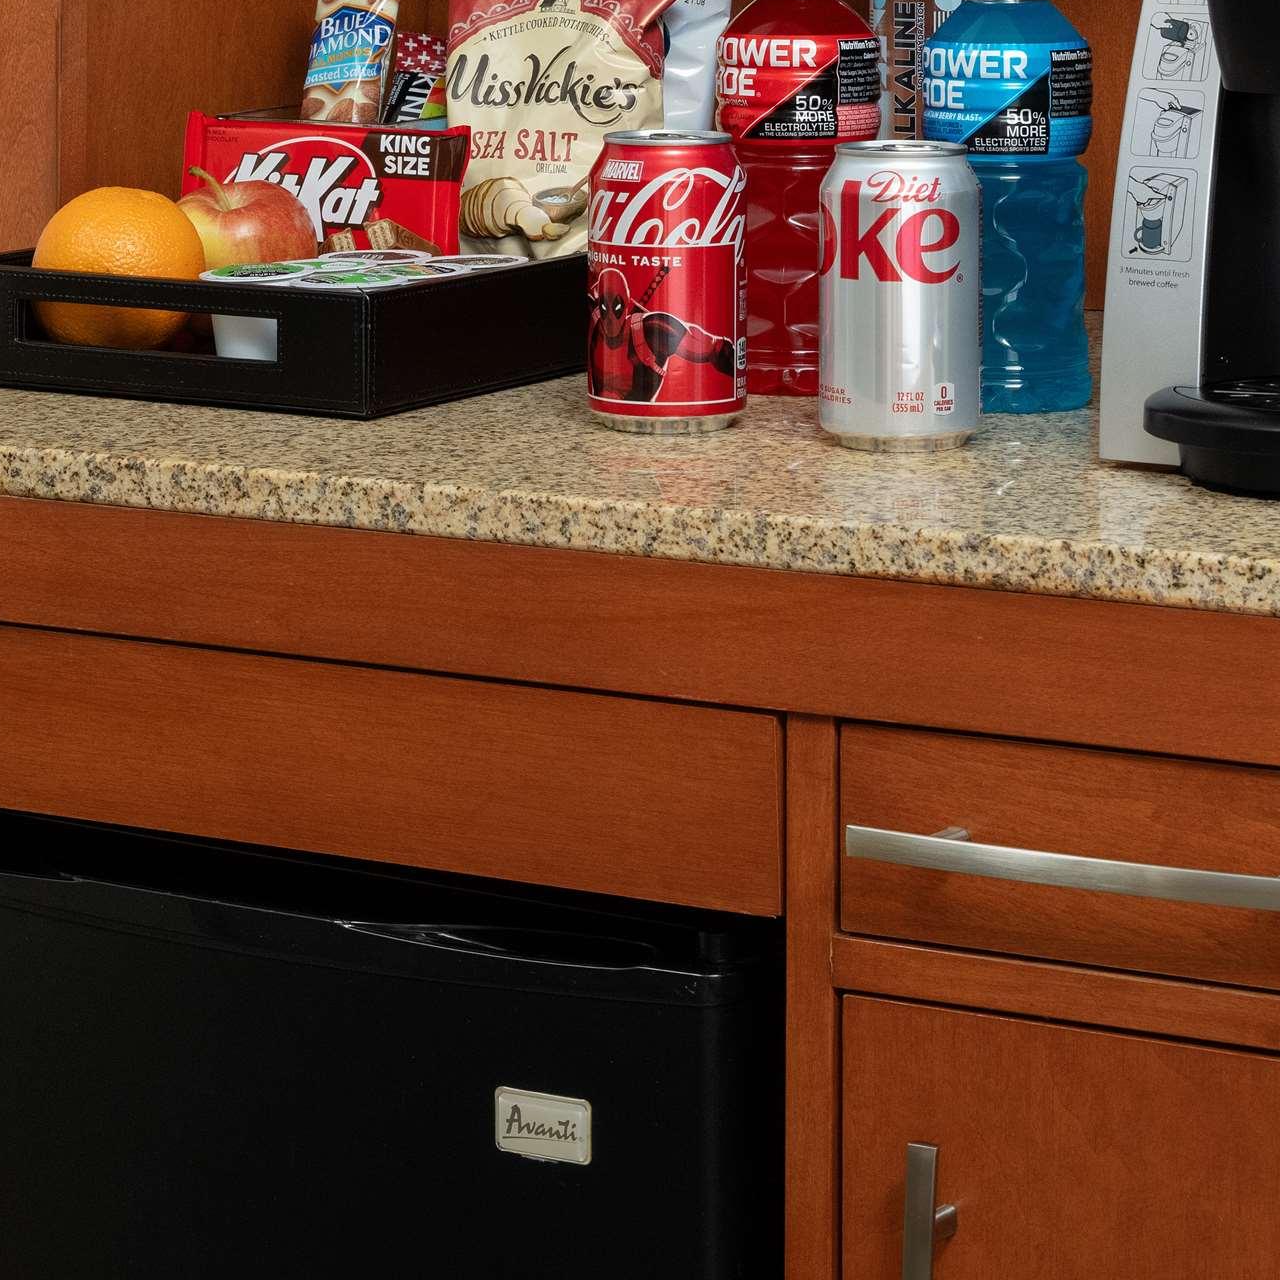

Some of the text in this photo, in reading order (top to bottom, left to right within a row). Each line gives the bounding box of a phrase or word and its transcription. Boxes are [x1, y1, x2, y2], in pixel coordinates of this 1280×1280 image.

[320, 11, 366, 39] BLUE
[489, 22, 526, 41] KETTLE
[525, 16, 559, 30] COOKED
[894, 1, 917, 140] LKALINE
[524, 46, 648, 124] Vickie's
[795, 95, 833, 111] 50%
[795, 110, 835, 122] MORE
[956, 113, 980, 121] BLAST
[1006, 108, 1046, 124] 50%
[1006, 125, 1047, 137] MORE
[380, 134, 431, 154] KING
[471, 128, 578, 162] SEA SALT
[384, 156, 430, 176] SIZE
[535, 162, 568, 174] ORIGINAL
[602, 161, 641, 181] MARVEL
[867, 170, 942, 203] Diet
[631, 255, 683, 268] TASTE
[1125, 266, 1154, 276] Minutes
[1154, 268, 1171, 277] until
[1172, 270, 1190, 279] fresh
[1128, 278, 1178, 289] brewed coffee
[896, 391, 925, 402] 12 FL OZ
[940, 385, 948, 400] 0
[892, 403, 909, 414] (355
[505, 1103, 578, 1141] Avanti
